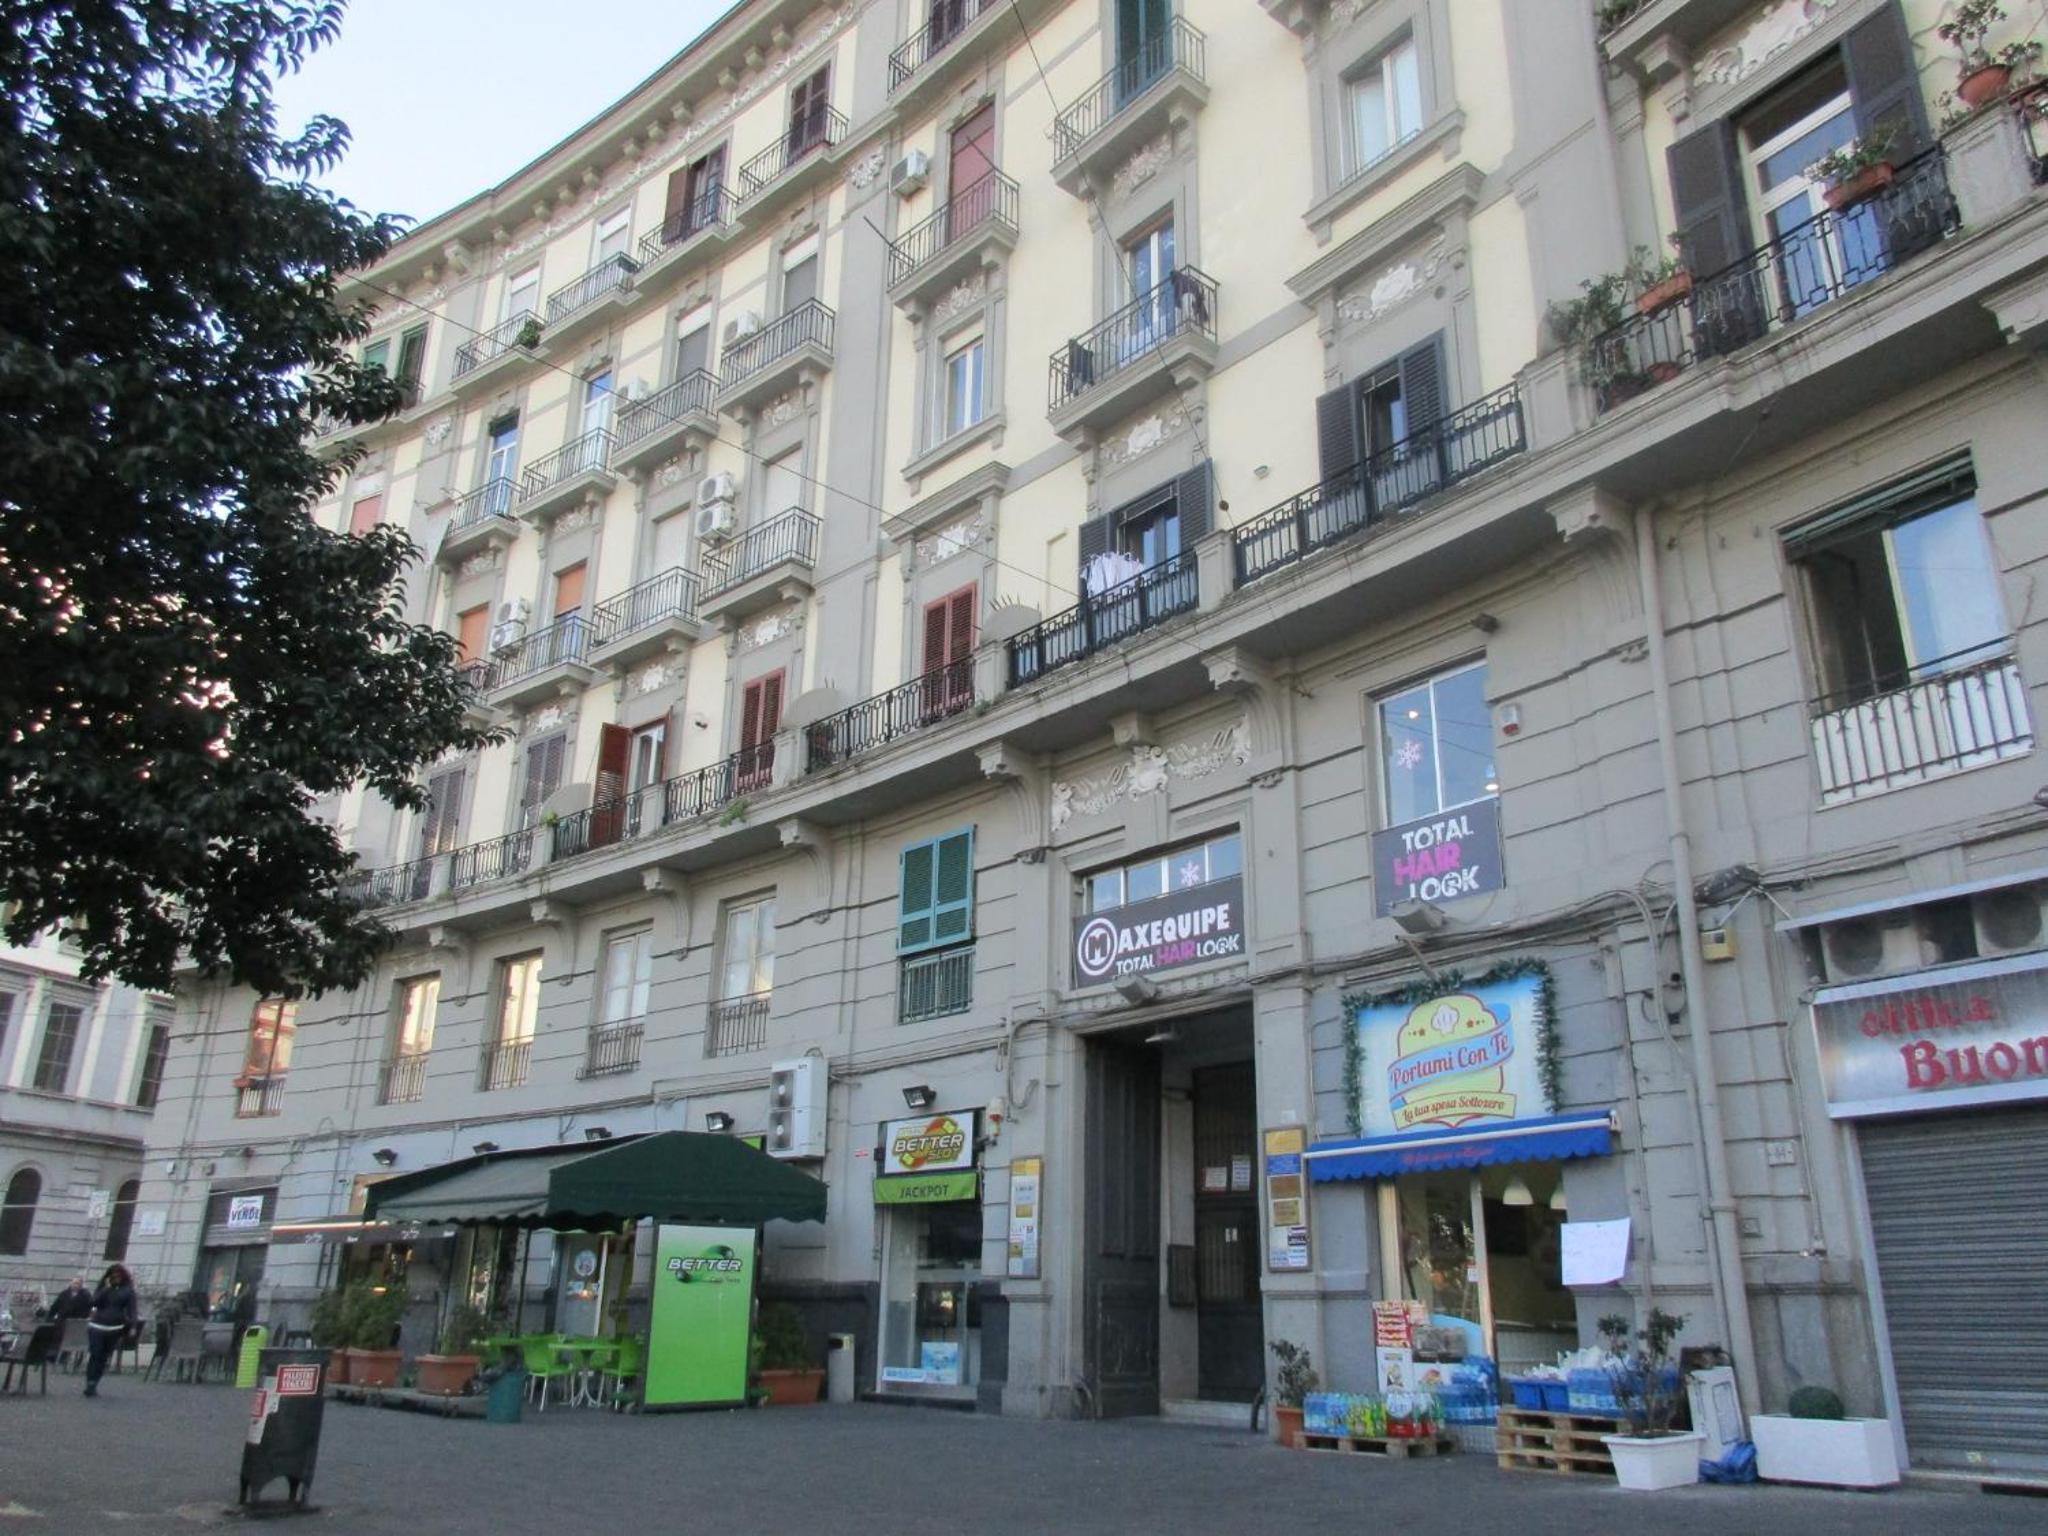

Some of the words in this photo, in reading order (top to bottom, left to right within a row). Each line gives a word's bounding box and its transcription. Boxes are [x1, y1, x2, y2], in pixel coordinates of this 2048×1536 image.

[1402, 815, 1474, 855] TOTAL
[1392, 841, 1463, 887] HAIR
[1116, 953, 1156, 976] TOTAL
[1156, 940, 1195, 966] HAIR
[1393, 1053, 1453, 1089] Portami
[1459, 1046, 1487, 1067] Con
[1404, 1109, 1413, 1122] La
[1415, 1104, 1429, 1116] tua
[1432, 1100, 1456, 1113] spesa
[1459, 1095, 1505, 1108] Sottozero
[894, 1134, 963, 1153] BETTER
[900, 1184, 949, 1199] JACKPOT
[668, 1258, 742, 1271] BETTER
